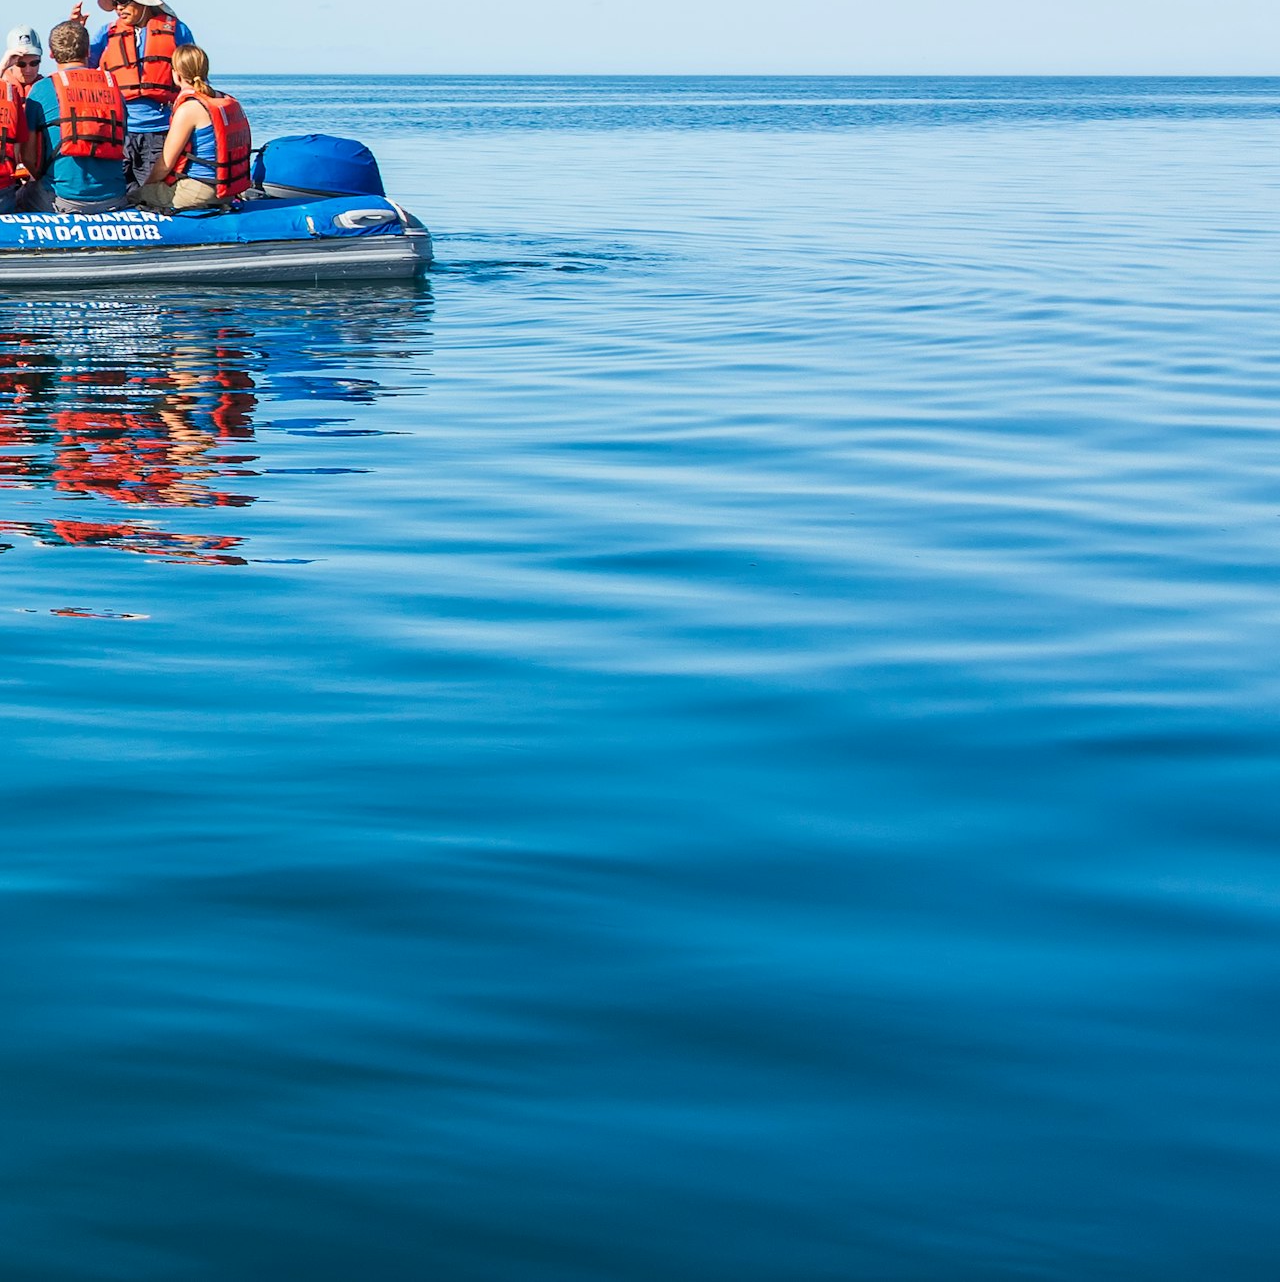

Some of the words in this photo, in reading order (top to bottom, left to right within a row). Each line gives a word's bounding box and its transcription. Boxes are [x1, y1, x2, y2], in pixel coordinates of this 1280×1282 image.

[65, 88, 116, 105] GUANTANAMERA
[21, 225, 54, 241] TN
[87, 224, 161, 241] 00008
